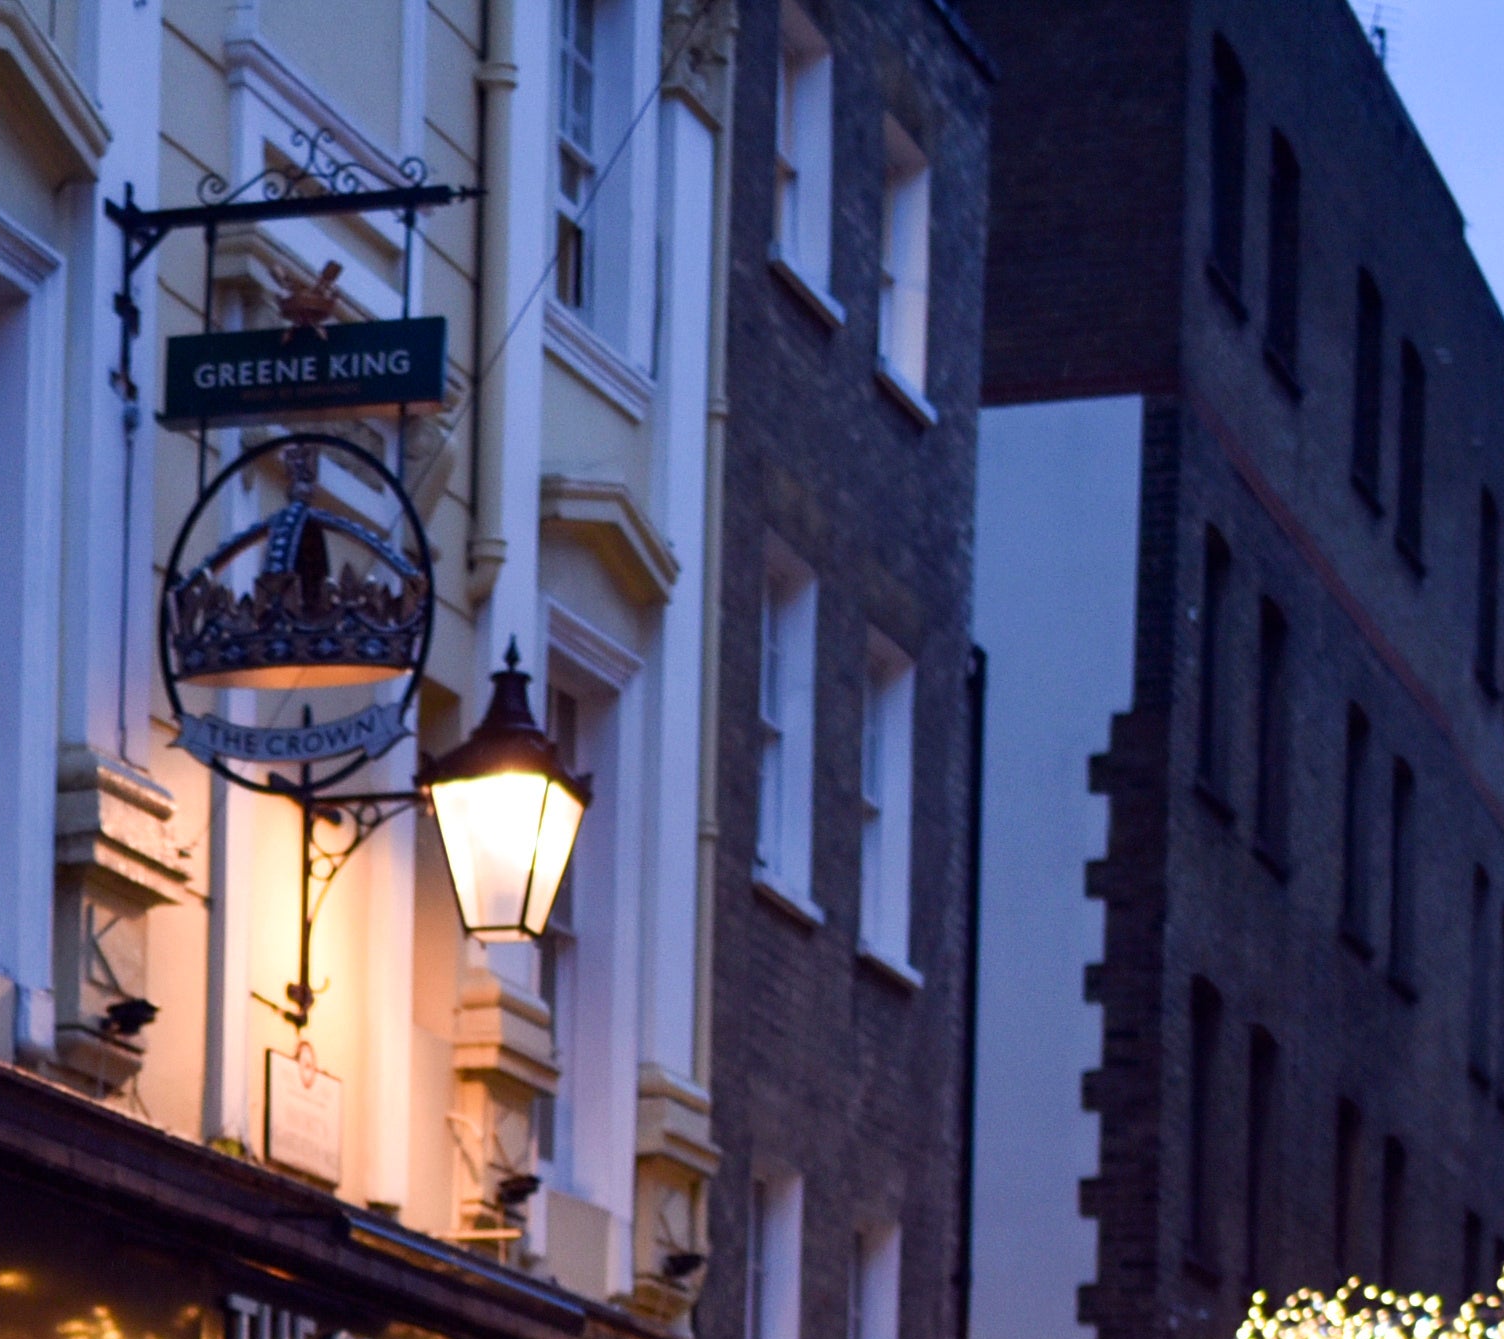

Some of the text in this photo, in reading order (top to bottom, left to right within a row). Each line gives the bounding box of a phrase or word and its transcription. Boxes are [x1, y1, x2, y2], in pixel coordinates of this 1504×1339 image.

[192, 348, 412, 390] GREENE KING
[205, 714, 377, 756] THE CROWN
